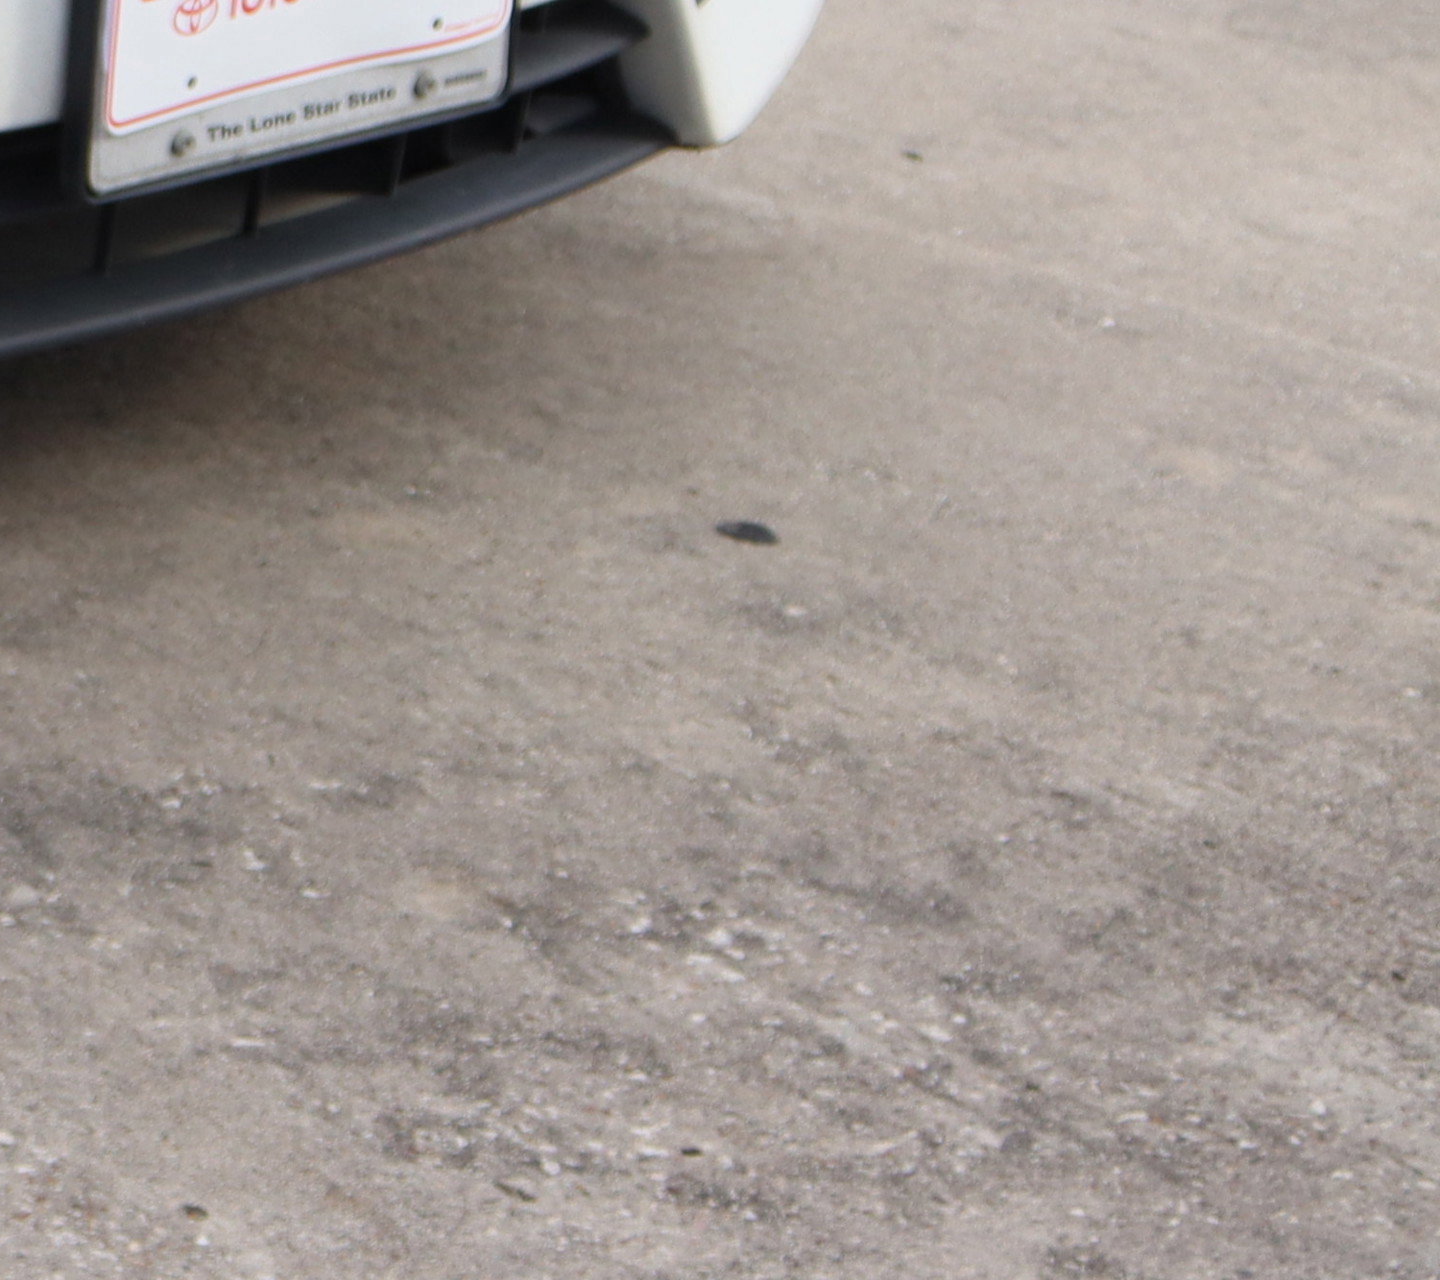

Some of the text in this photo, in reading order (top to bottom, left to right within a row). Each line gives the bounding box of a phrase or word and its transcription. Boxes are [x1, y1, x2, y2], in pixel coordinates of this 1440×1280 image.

[207, 86, 397, 142] The Lone Star State
